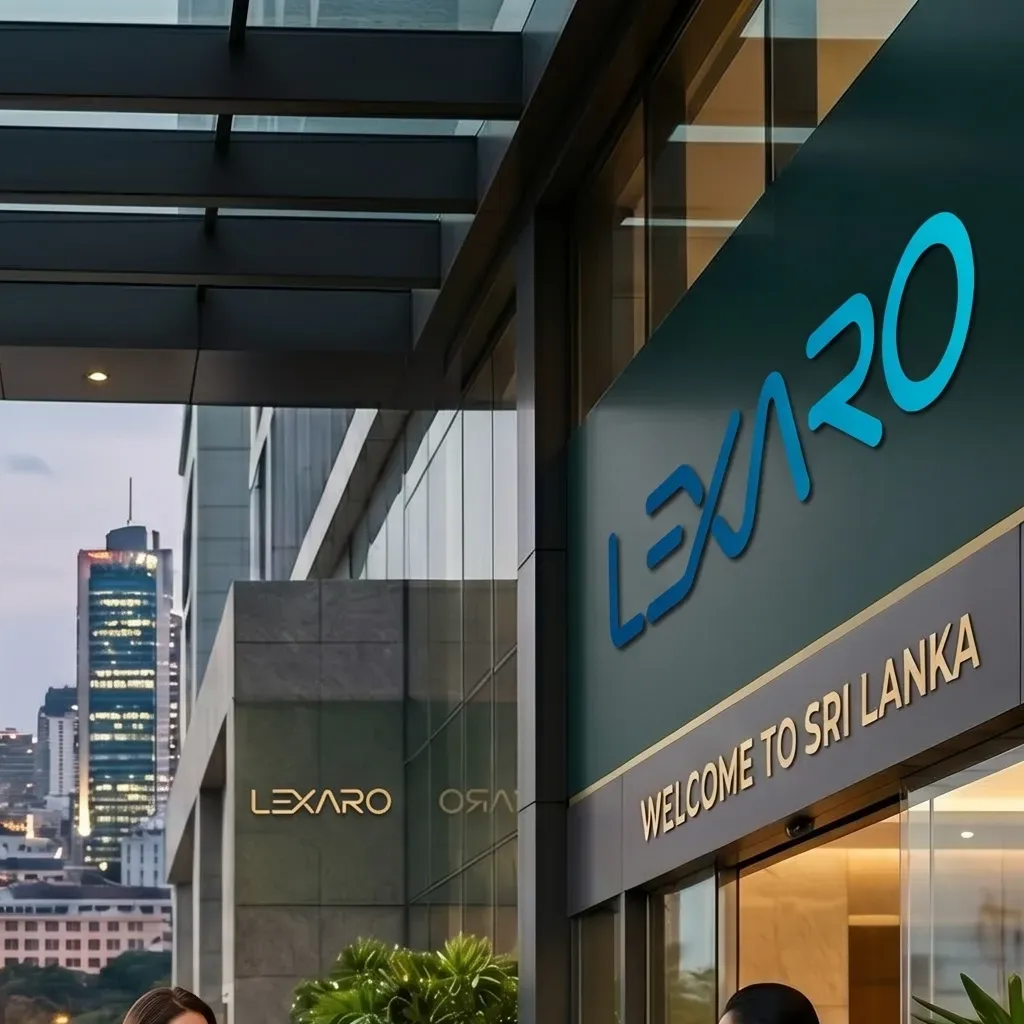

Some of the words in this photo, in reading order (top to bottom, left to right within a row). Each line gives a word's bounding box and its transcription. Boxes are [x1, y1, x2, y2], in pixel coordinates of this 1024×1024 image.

[608, 211, 975, 648] LEXARO
[250, 788, 392, 815] LEXARO
[640, 737, 753, 842] WELCOME
[760, 716, 797, 778] TO
[804, 682, 850, 755] SRI
[861, 612, 981, 727] LANKA
